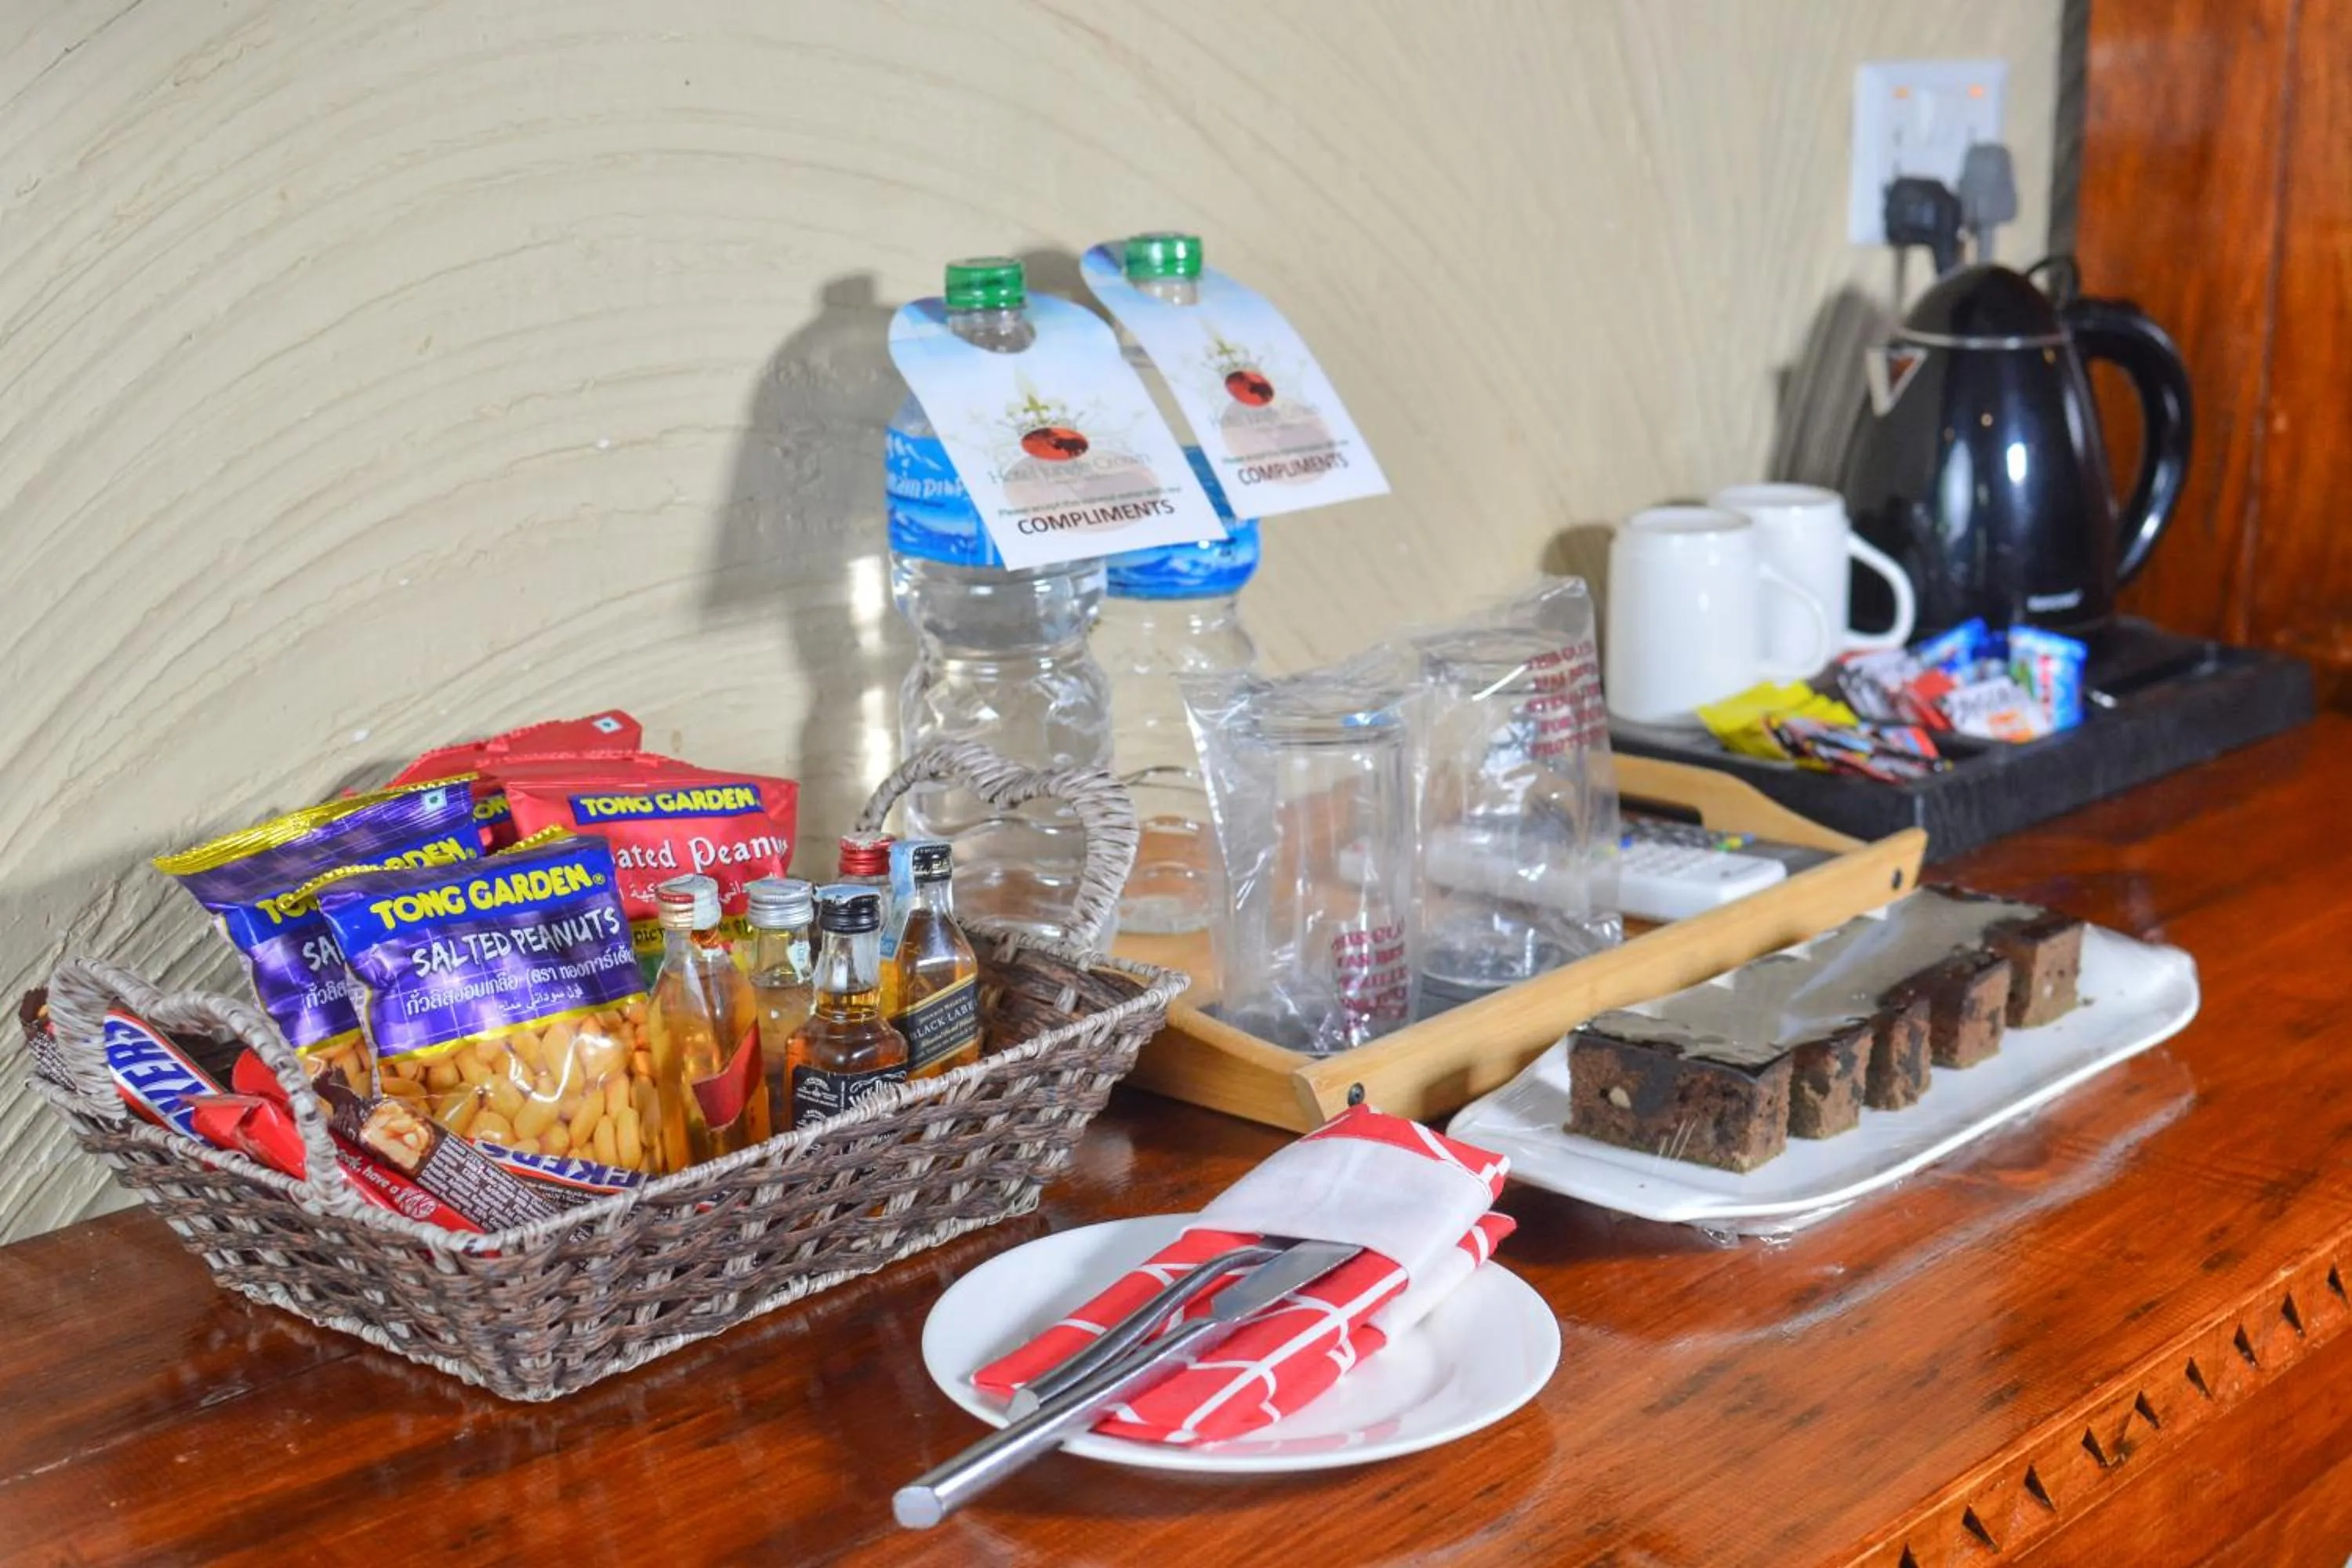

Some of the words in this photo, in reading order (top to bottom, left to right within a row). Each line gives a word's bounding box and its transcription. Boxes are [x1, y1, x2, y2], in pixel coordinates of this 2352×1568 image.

[1238, 452, 1348, 485] COMPLIMENTS
[1018, 499, 1175, 535] COMPLIMENTS
[580, 796, 654, 817] TONG
[655, 787, 757, 813] GARDEN
[612, 840, 678, 869] ated
[370, 886, 467, 930] TONG
[468, 864, 593, 910] GARDEN
[412, 932, 511, 978] SALTED
[510, 906, 621, 954] PEANUTS
[361, 1165, 389, 1189] have
